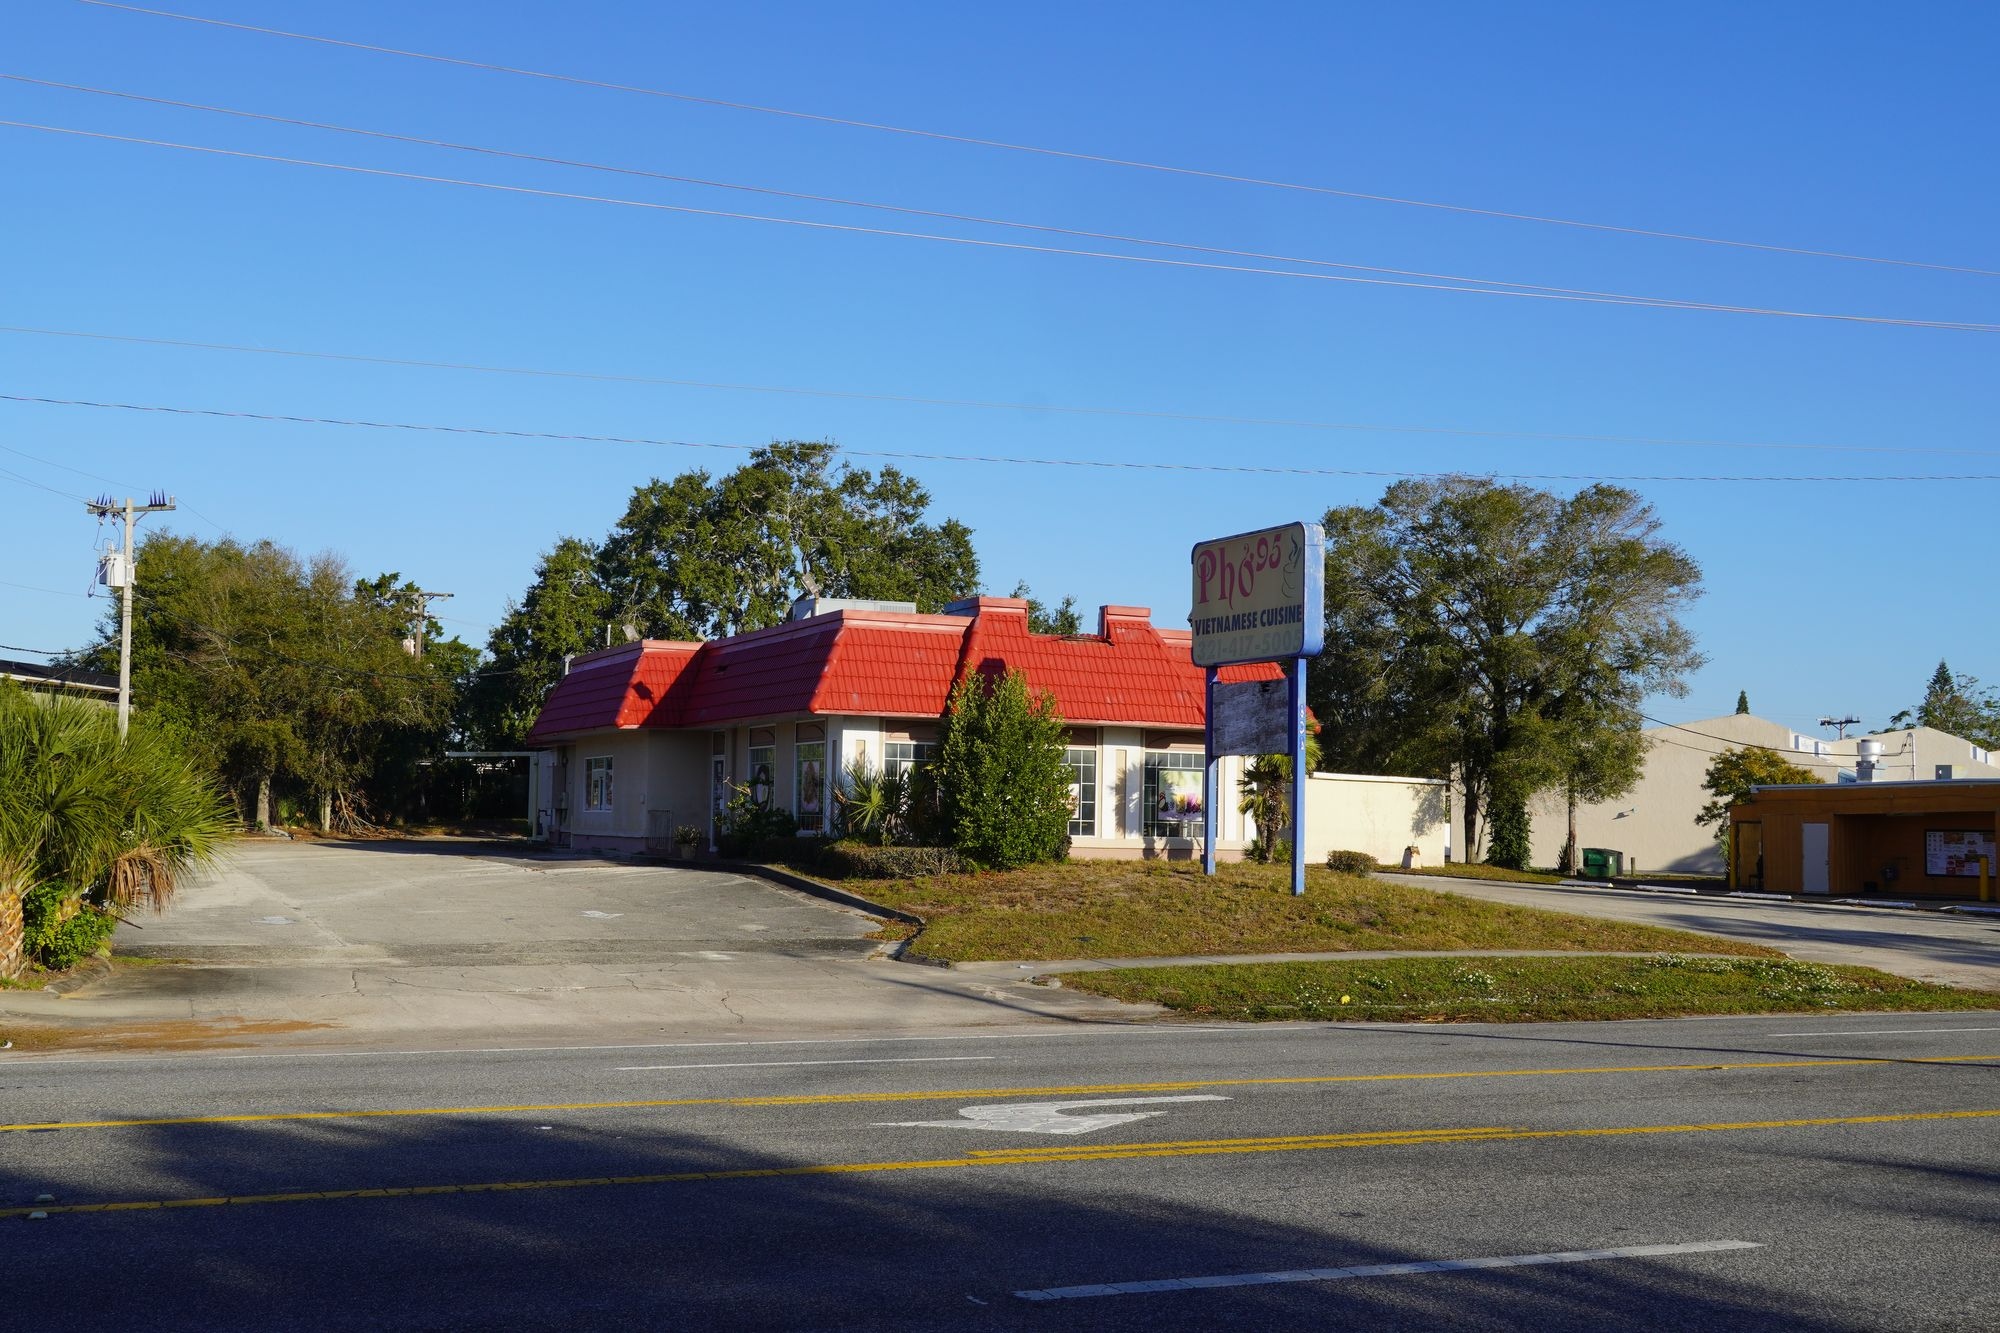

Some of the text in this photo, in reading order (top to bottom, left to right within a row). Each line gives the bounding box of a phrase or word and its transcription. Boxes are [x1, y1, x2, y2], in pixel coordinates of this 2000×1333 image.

[1256, 533, 1282, 572] 95
[1195, 604, 1302, 636] VIETNAMESE CUISINE
